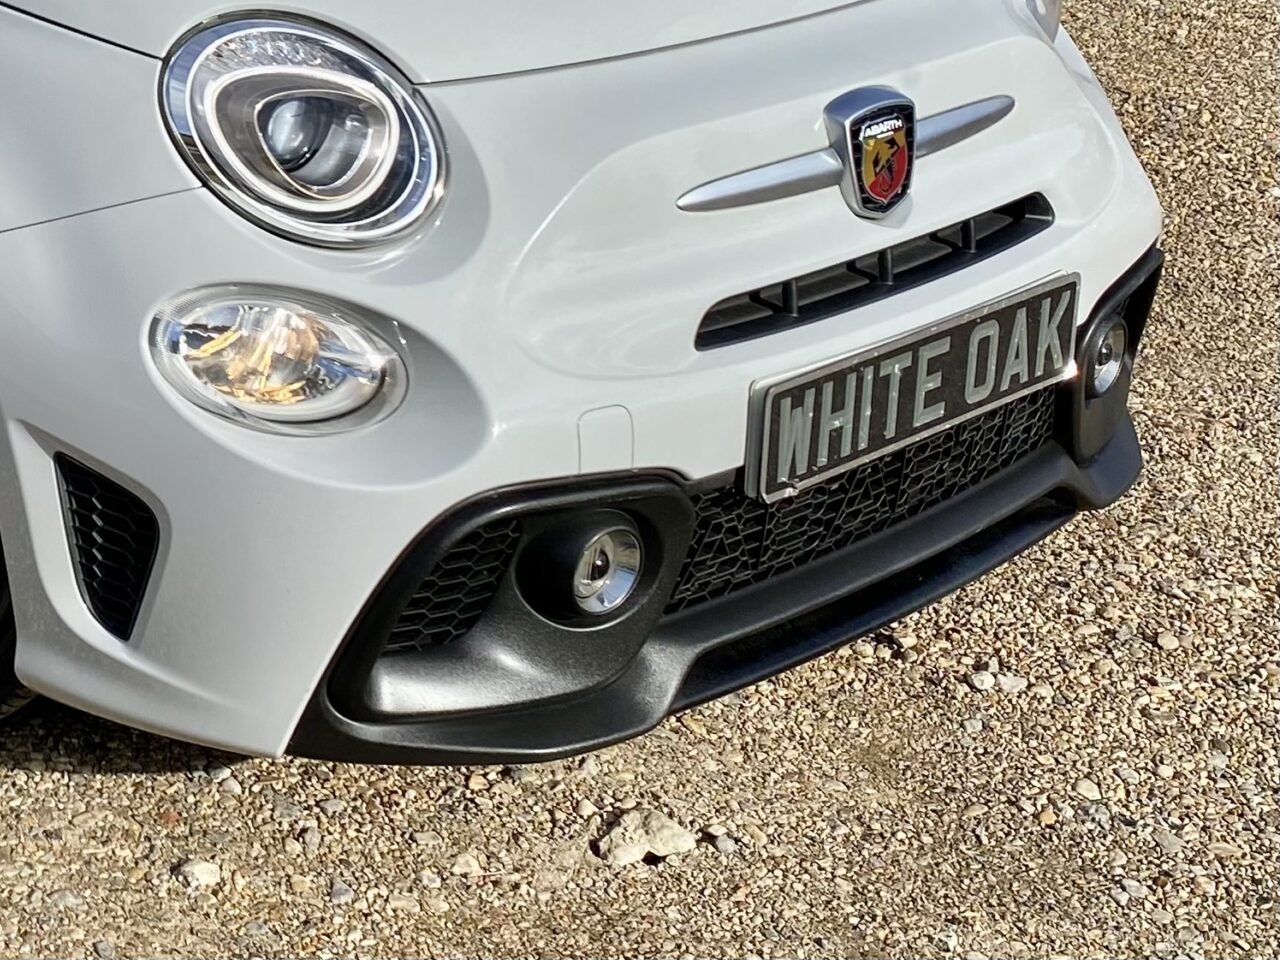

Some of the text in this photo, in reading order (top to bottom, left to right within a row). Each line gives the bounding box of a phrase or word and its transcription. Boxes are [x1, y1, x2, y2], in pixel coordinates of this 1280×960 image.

[864, 119, 903, 138] ABARTH
[776, 290, 1072, 484] WHITE OAK
